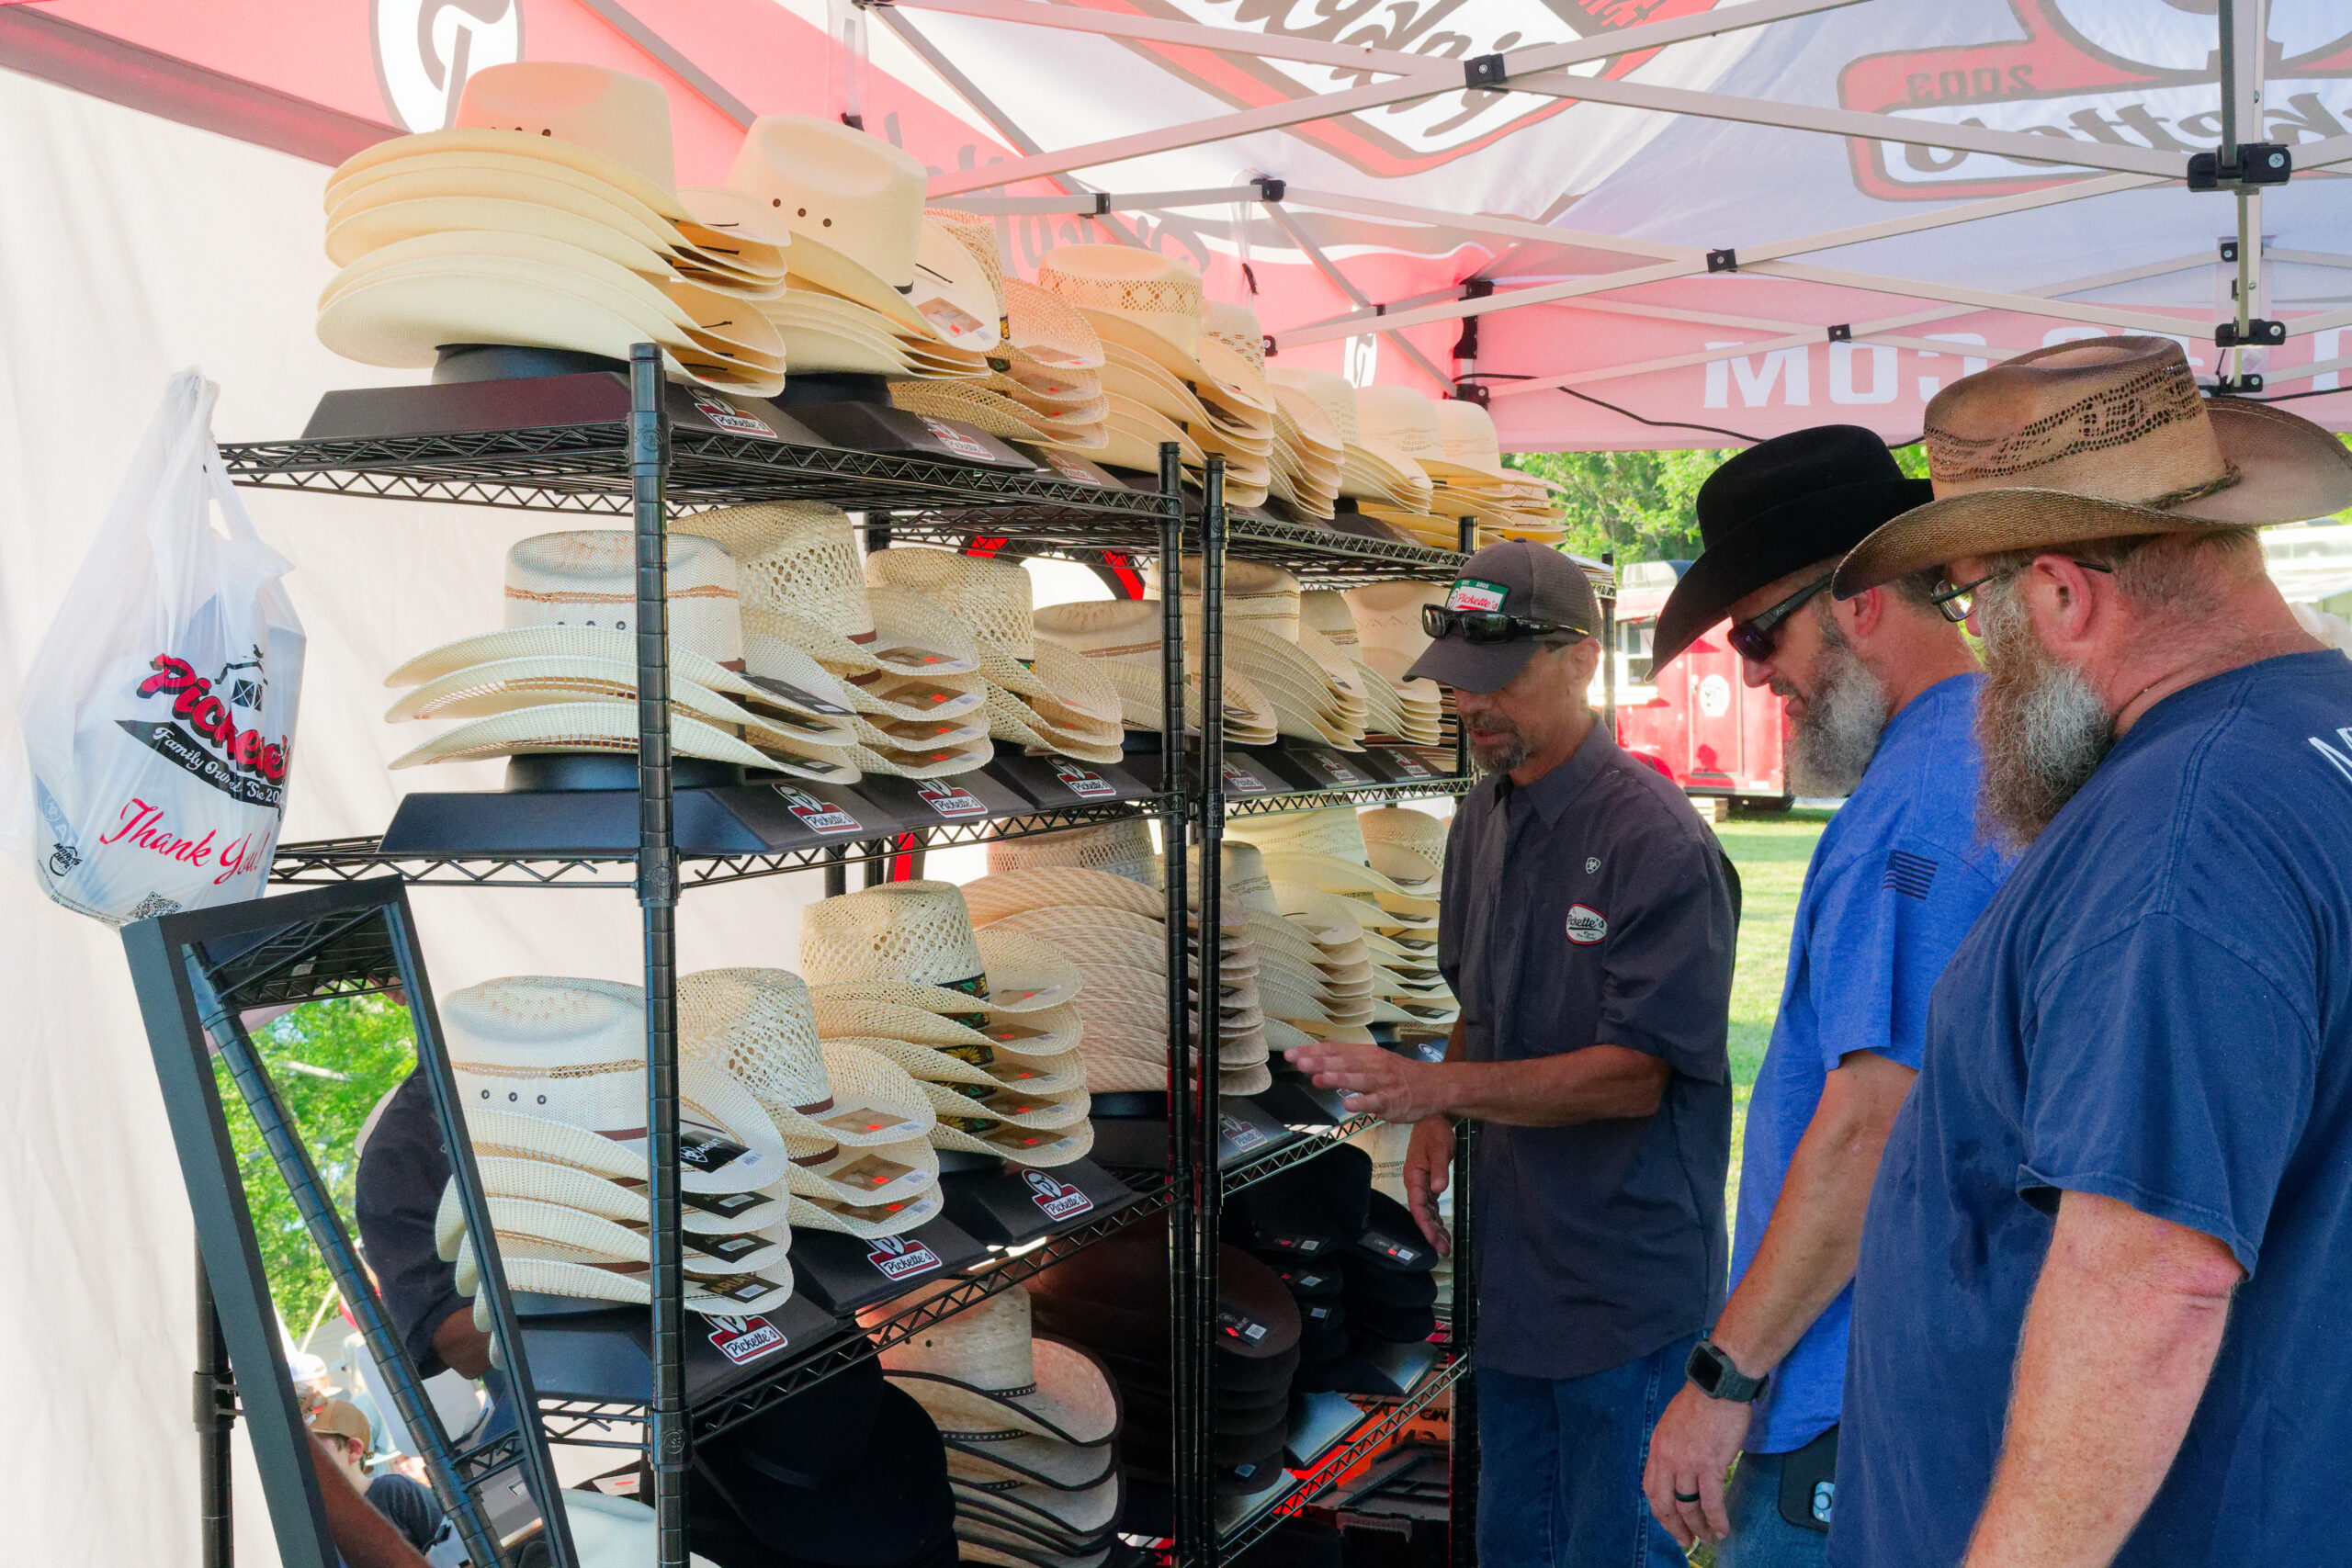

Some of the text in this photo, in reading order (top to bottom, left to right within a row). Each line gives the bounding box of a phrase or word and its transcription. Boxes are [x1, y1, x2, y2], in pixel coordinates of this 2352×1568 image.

[1456, 592, 1498, 610] Pickette's
[153, 727, 205, 771] Family
[933, 797, 978, 811] Pickette's
[807, 814, 852, 828] Pickette's
[99, 797, 268, 886] Thank You!
[1046, 1195, 1085, 1213] Pickette's
[884, 1252, 932, 1273] Pickette's
[726, 1330, 777, 1356] Pickette's
